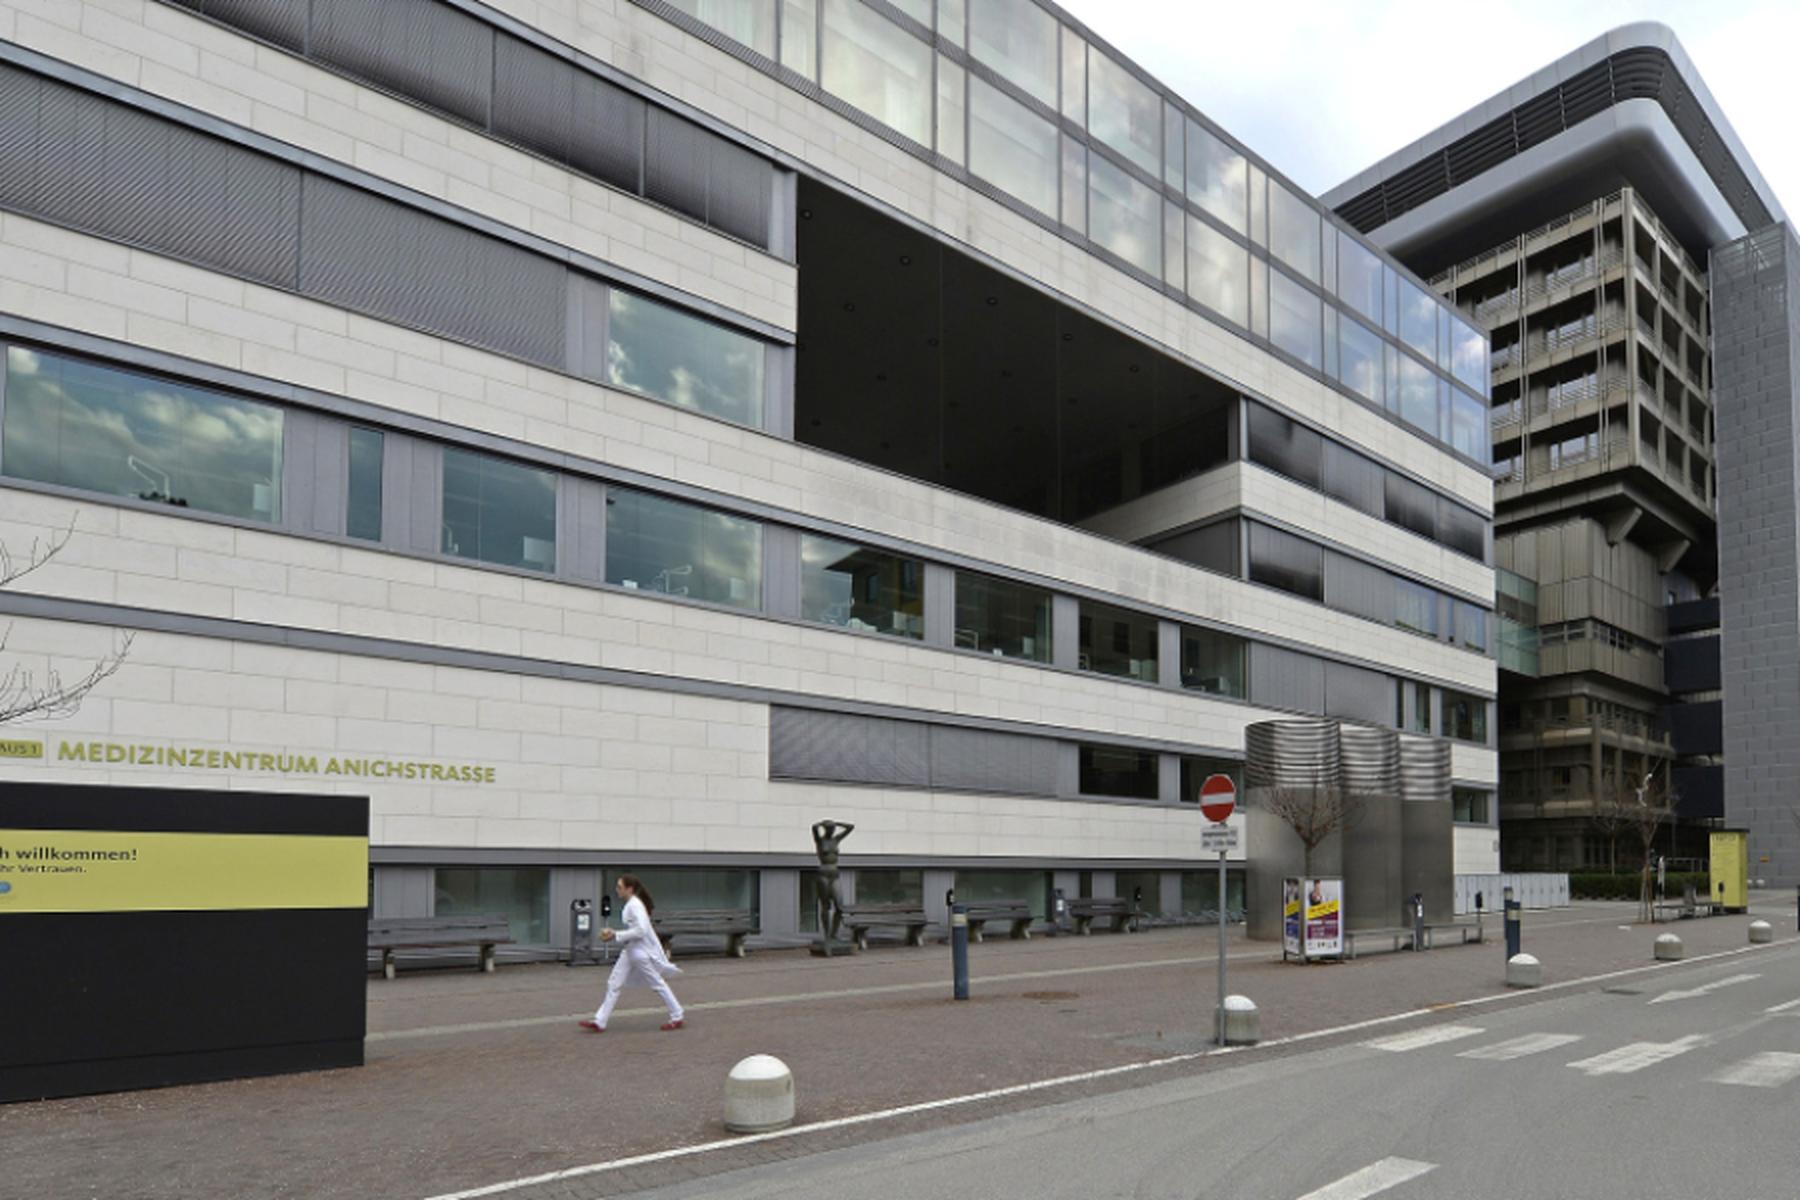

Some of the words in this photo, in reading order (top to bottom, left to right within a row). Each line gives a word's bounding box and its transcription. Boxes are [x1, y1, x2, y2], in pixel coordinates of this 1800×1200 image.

[58, 741, 317, 773] MEDIZINZENTRUM
[325, 757, 496, 784] ANICHSTRASSE
[16, 846, 137, 861] willkommen!
[18, 864, 87, 873] Vertrauen.
